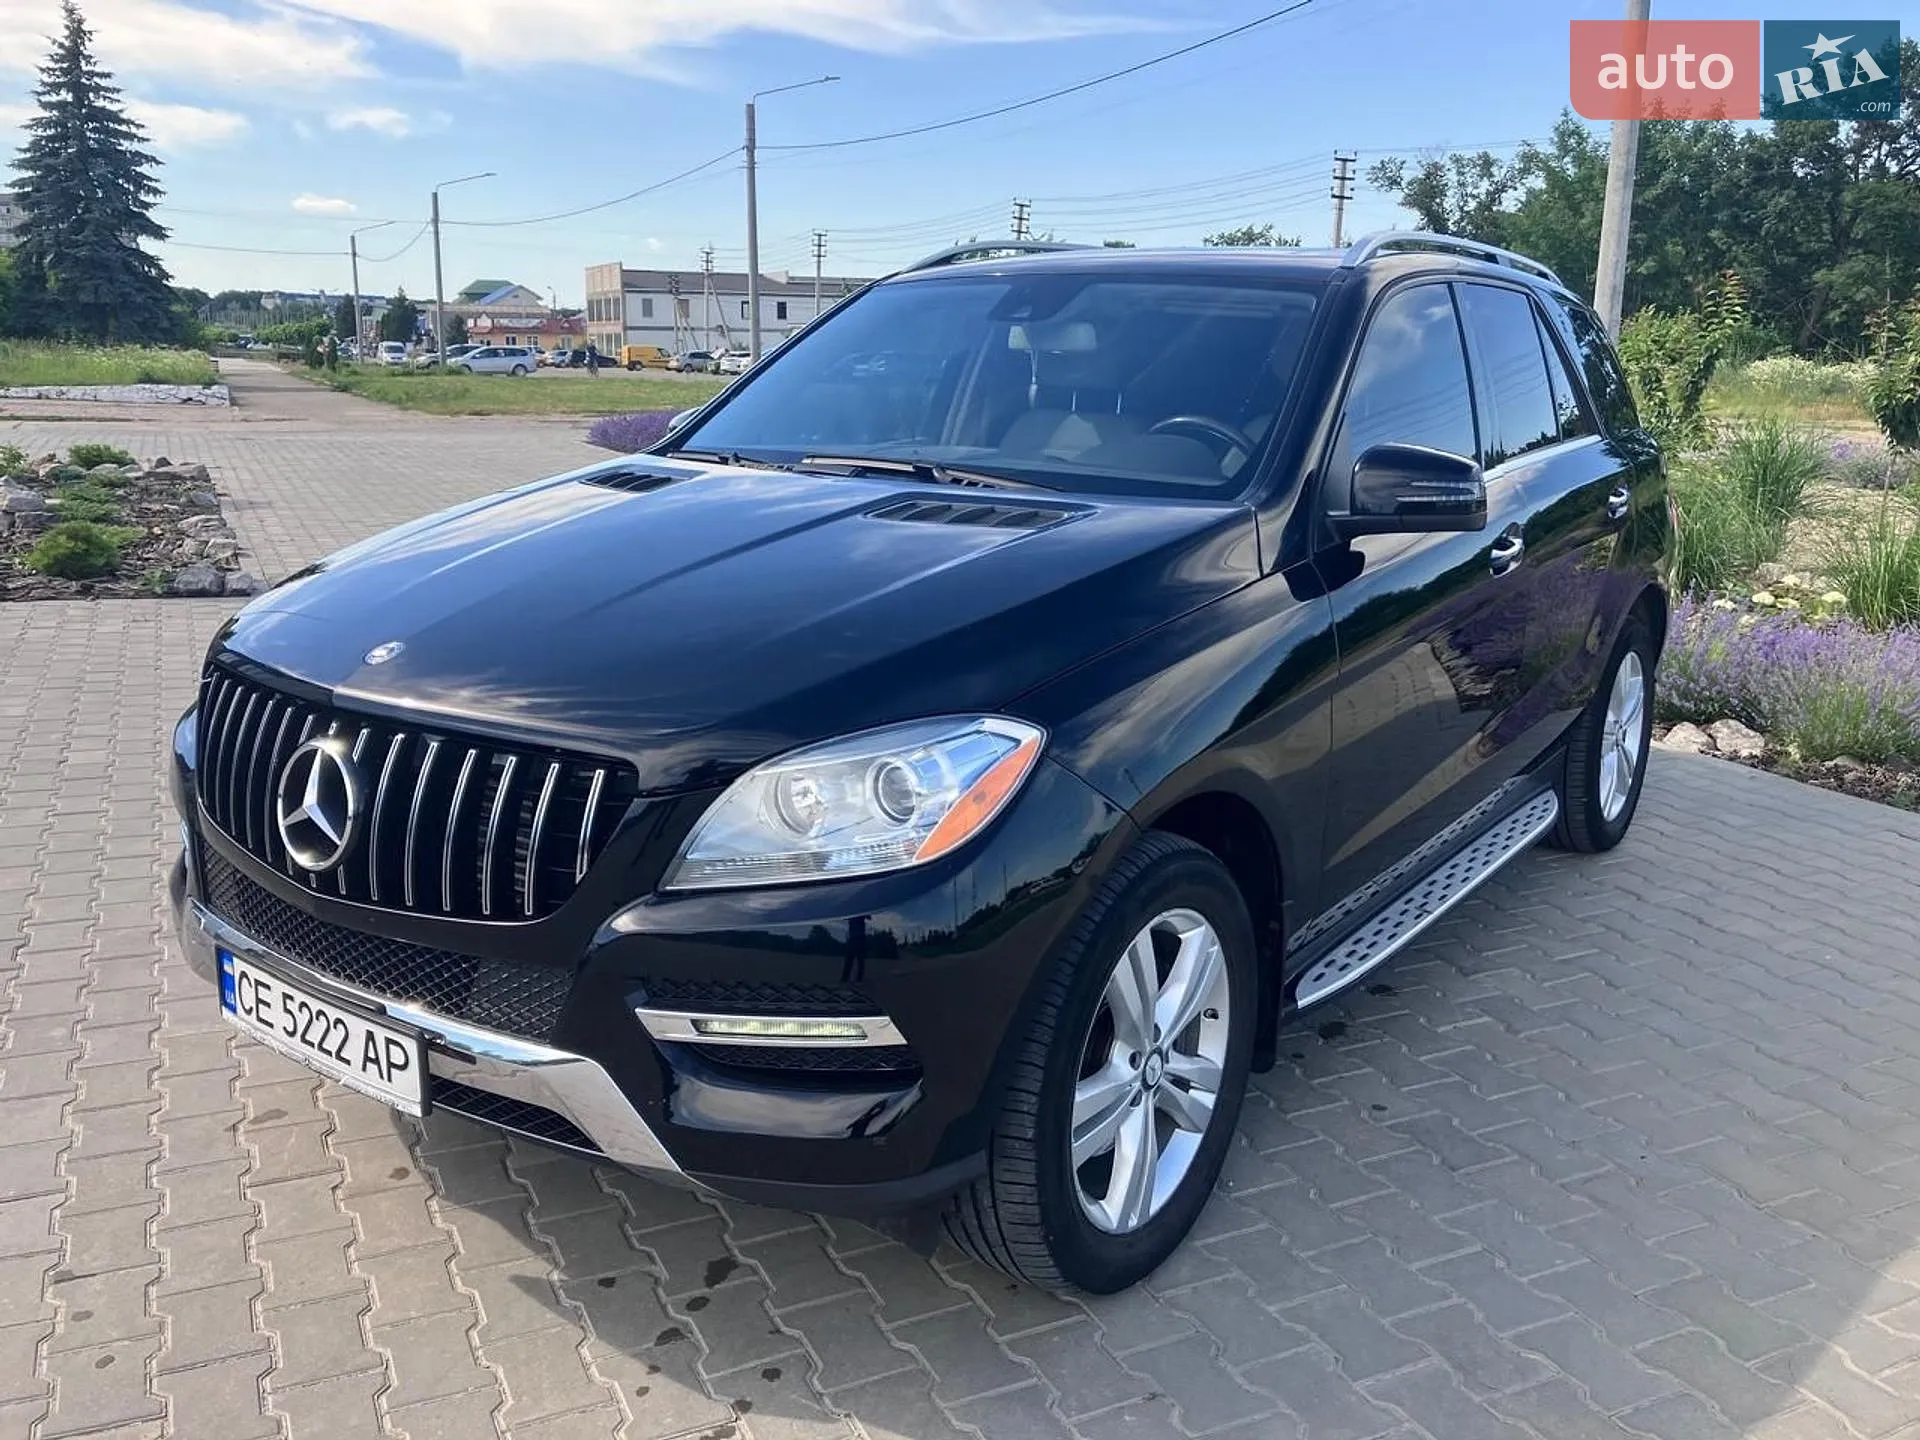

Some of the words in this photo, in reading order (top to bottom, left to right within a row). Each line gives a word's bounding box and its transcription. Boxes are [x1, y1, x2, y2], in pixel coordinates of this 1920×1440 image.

[238, 970, 274, 1029] CE
[282, 991, 351, 1066] 5222
[361, 1029, 409, 1083] AP
